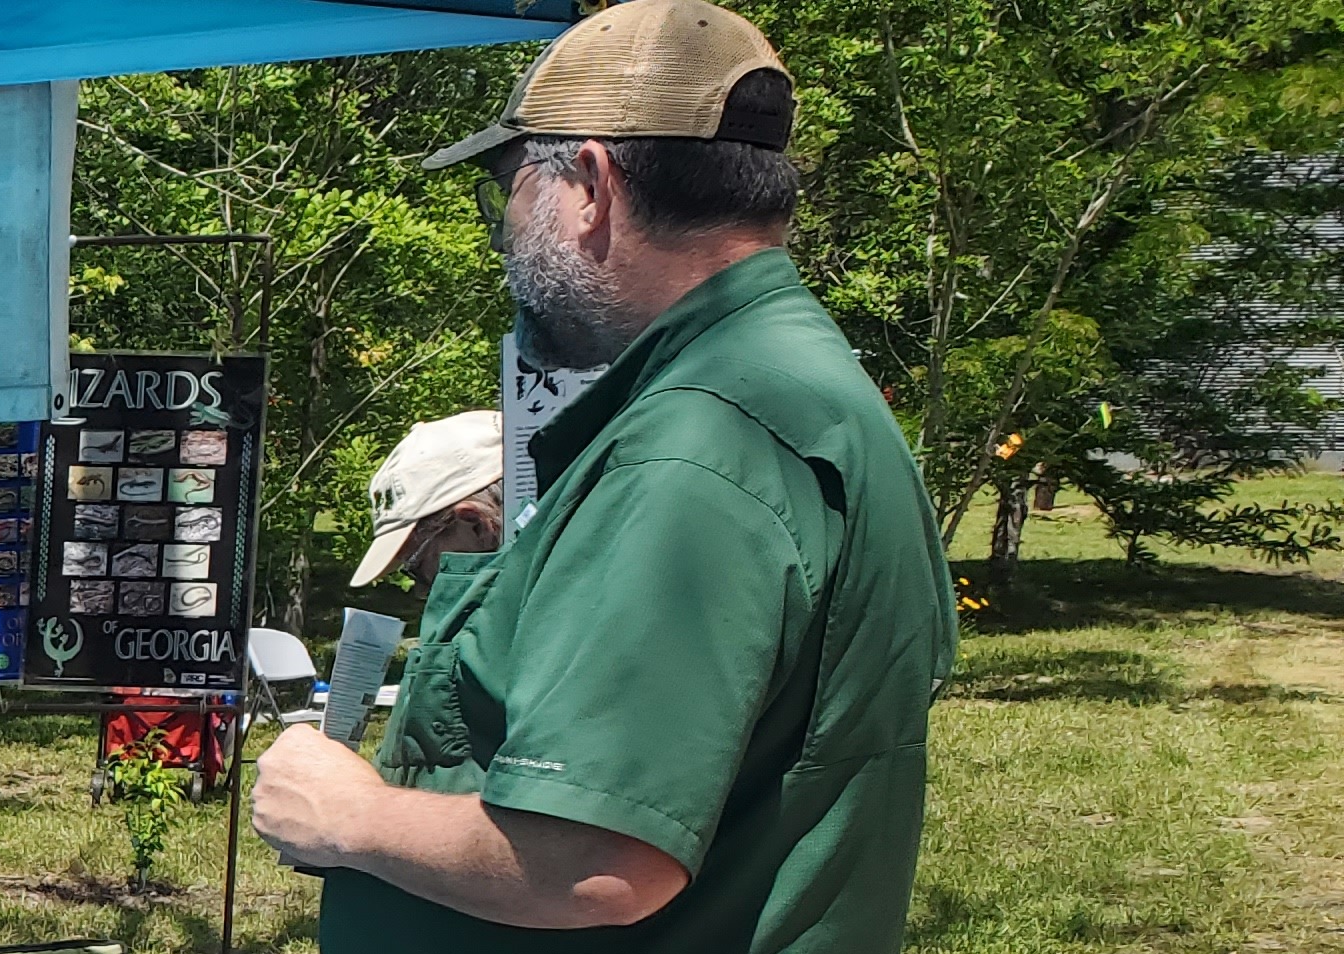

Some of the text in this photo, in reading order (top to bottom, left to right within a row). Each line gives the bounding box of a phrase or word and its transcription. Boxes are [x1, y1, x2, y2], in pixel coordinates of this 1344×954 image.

[62, 368, 223, 416] IZARDS
[103, 619, 119, 634] OF
[114, 628, 237, 663] GEORGIA
